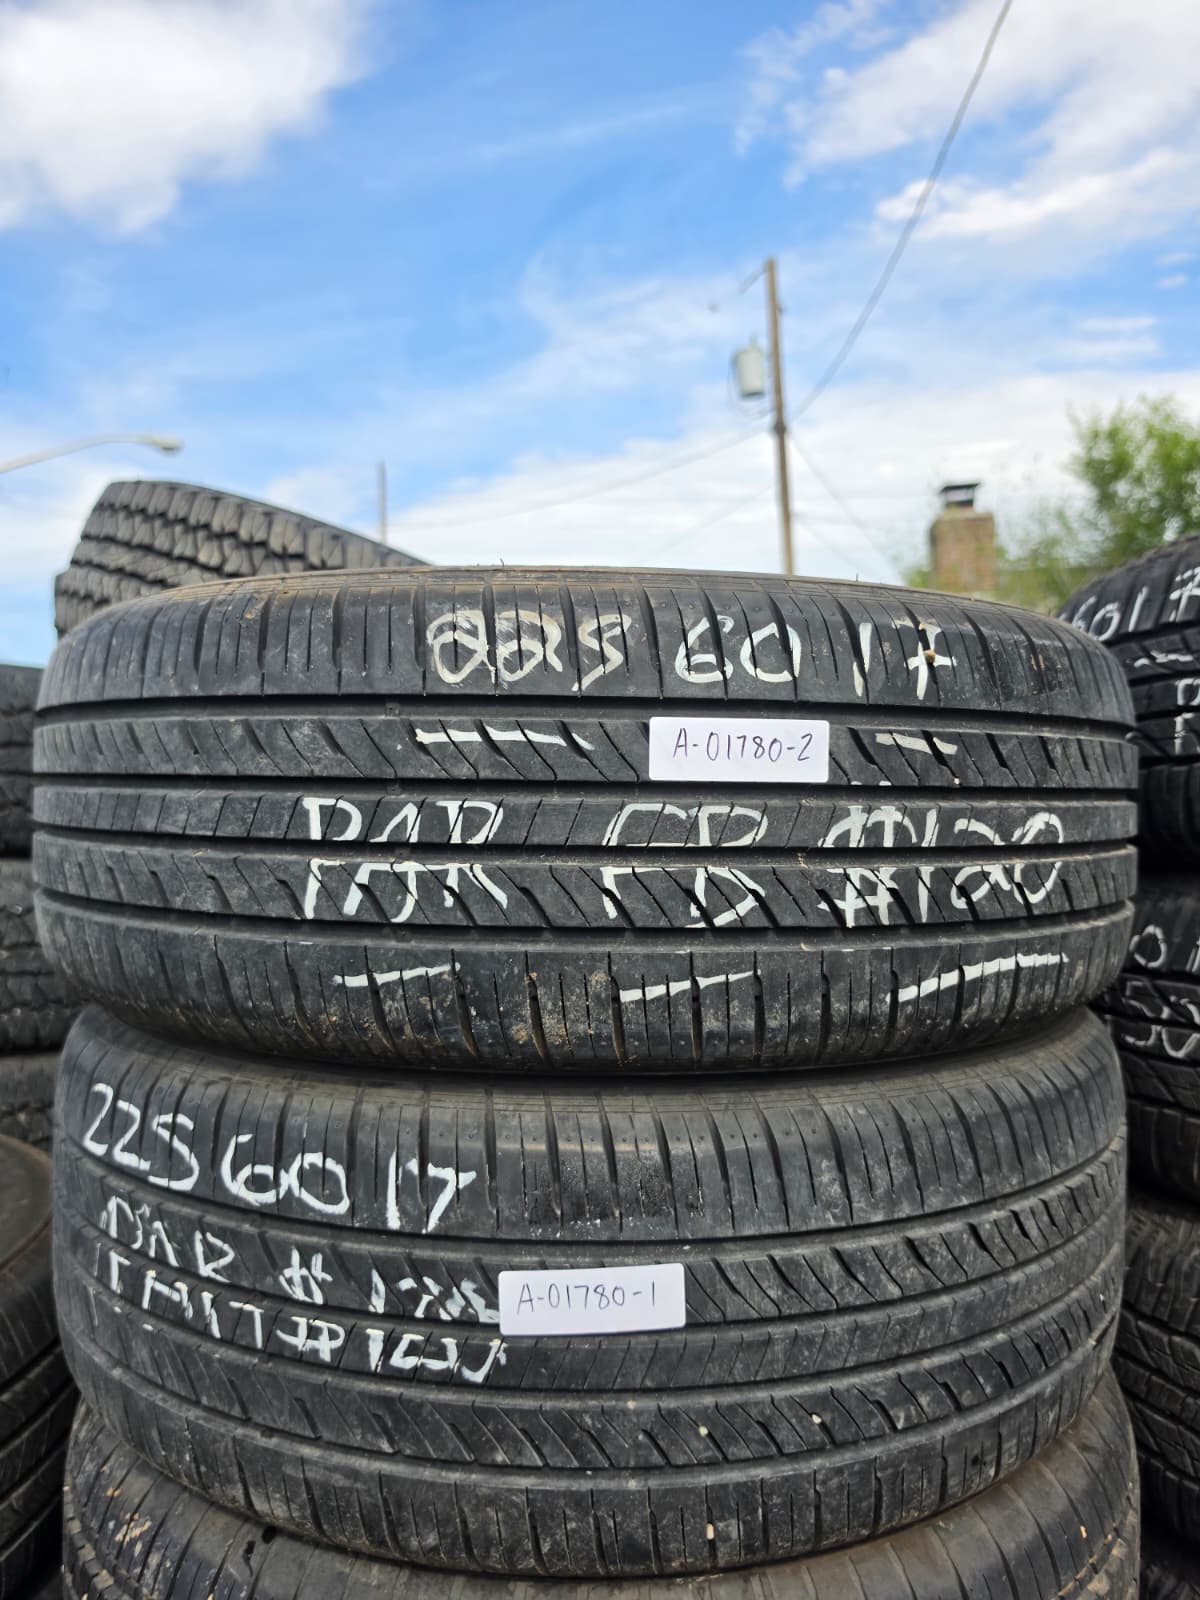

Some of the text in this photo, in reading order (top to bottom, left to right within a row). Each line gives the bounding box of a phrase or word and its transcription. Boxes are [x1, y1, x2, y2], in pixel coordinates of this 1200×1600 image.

[674, 616, 803, 684] 60
[852, 619, 957, 699] 17
[672, 727, 814, 763] A-01780-2
[82, 1083, 477, 1233] 225 60 17
[516, 1281, 656, 1316] A-01780-1
